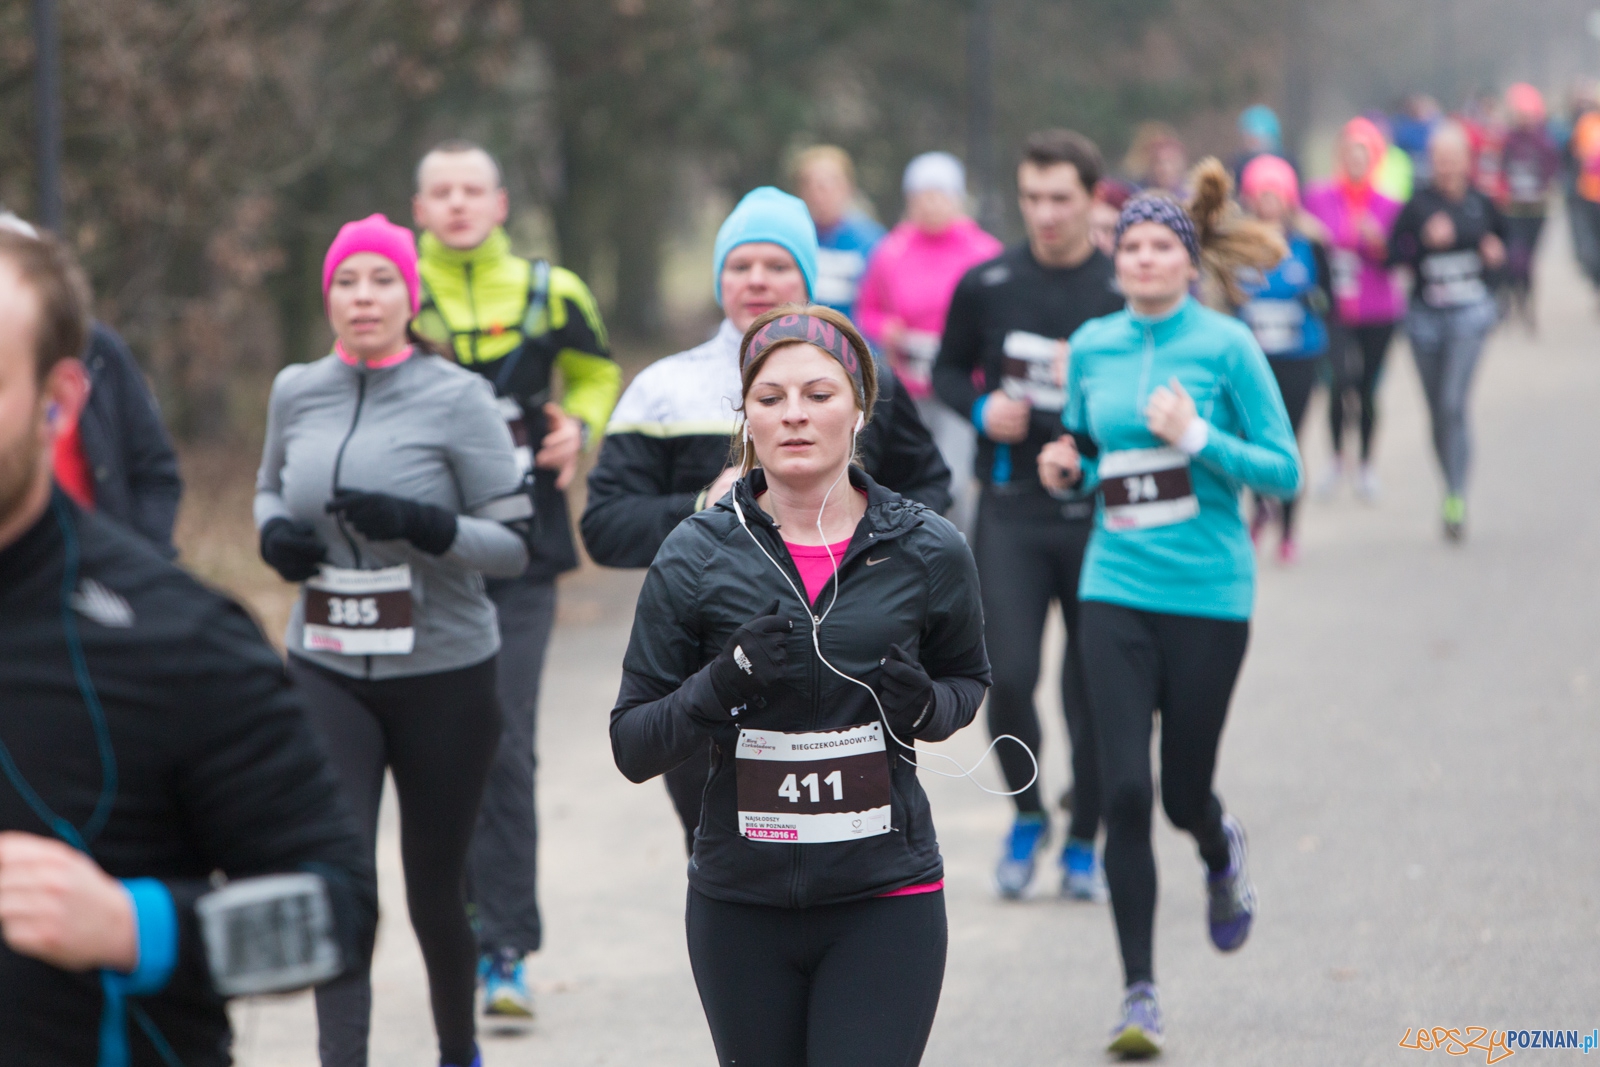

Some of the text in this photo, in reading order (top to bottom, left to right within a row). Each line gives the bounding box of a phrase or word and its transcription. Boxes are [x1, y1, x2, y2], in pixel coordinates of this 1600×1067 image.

[327, 596, 380, 626] 385
[791, 735, 878, 751] BIEGCZEKOLADOWY.PL
[778, 770, 844, 803] 411
[746, 829, 789, 839] 14.02.2016
